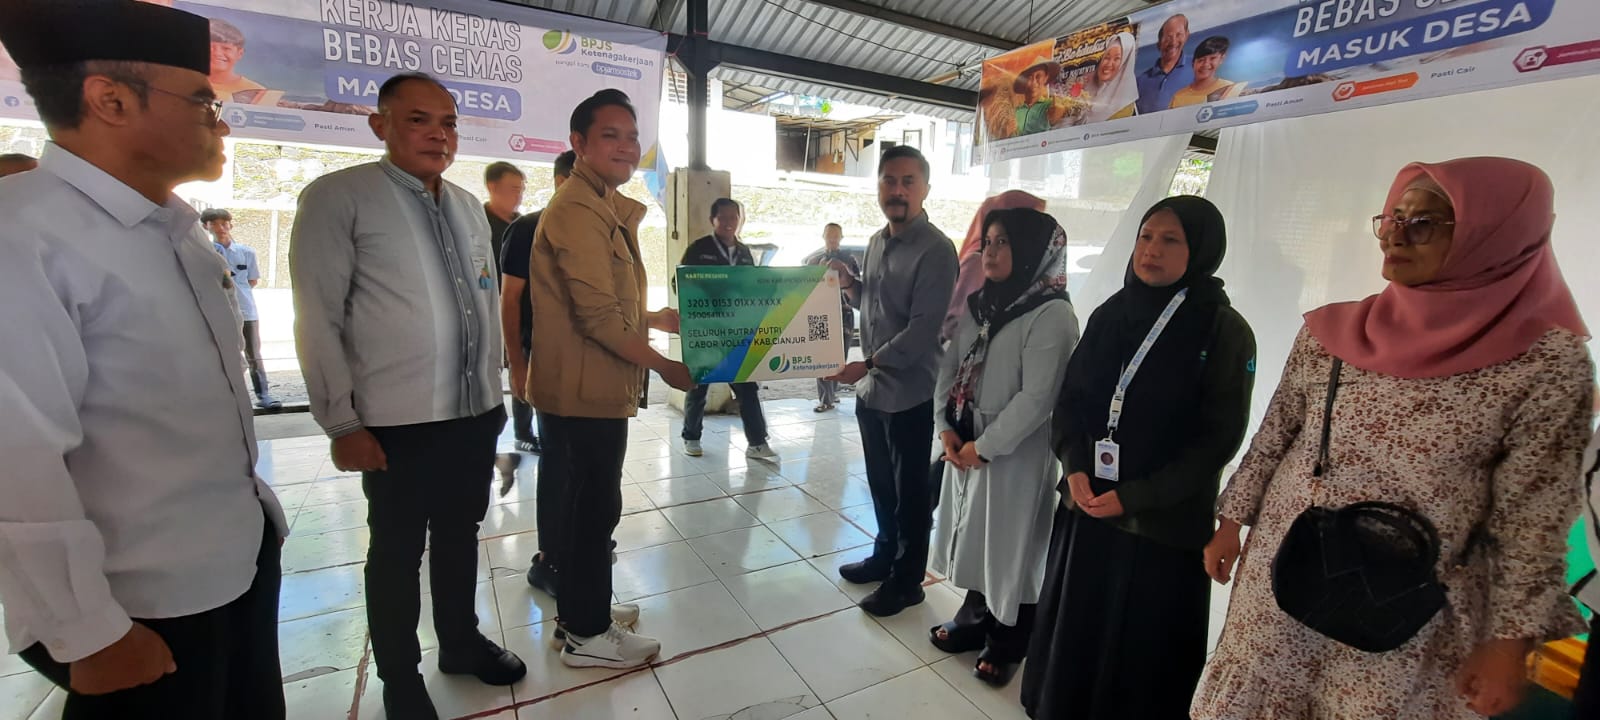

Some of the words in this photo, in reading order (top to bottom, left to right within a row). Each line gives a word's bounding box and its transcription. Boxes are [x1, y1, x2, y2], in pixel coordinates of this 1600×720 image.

[321, 0, 422, 37] KERJA
[430, 7, 521, 51] KERAS
[1296, 26, 1414, 69] MASUK
[1423, 1, 1532, 44] DESA
[580, 37, 613, 51] BPJS
[322, 28, 421, 72] BEBAS
[431, 44, 523, 83] CEMAS
[580, 48, 654, 67] Ketenagakerjaan
[1430, 69, 1454, 79] Pasti
[1456, 66, 1476, 75] Cair
[687, 299, 710, 308] 3203
[711, 299, 732, 308] 0153
[687, 327, 726, 338] SELURUH
[688, 340, 719, 349] CABOR
[792, 356, 813, 365] BPJS
